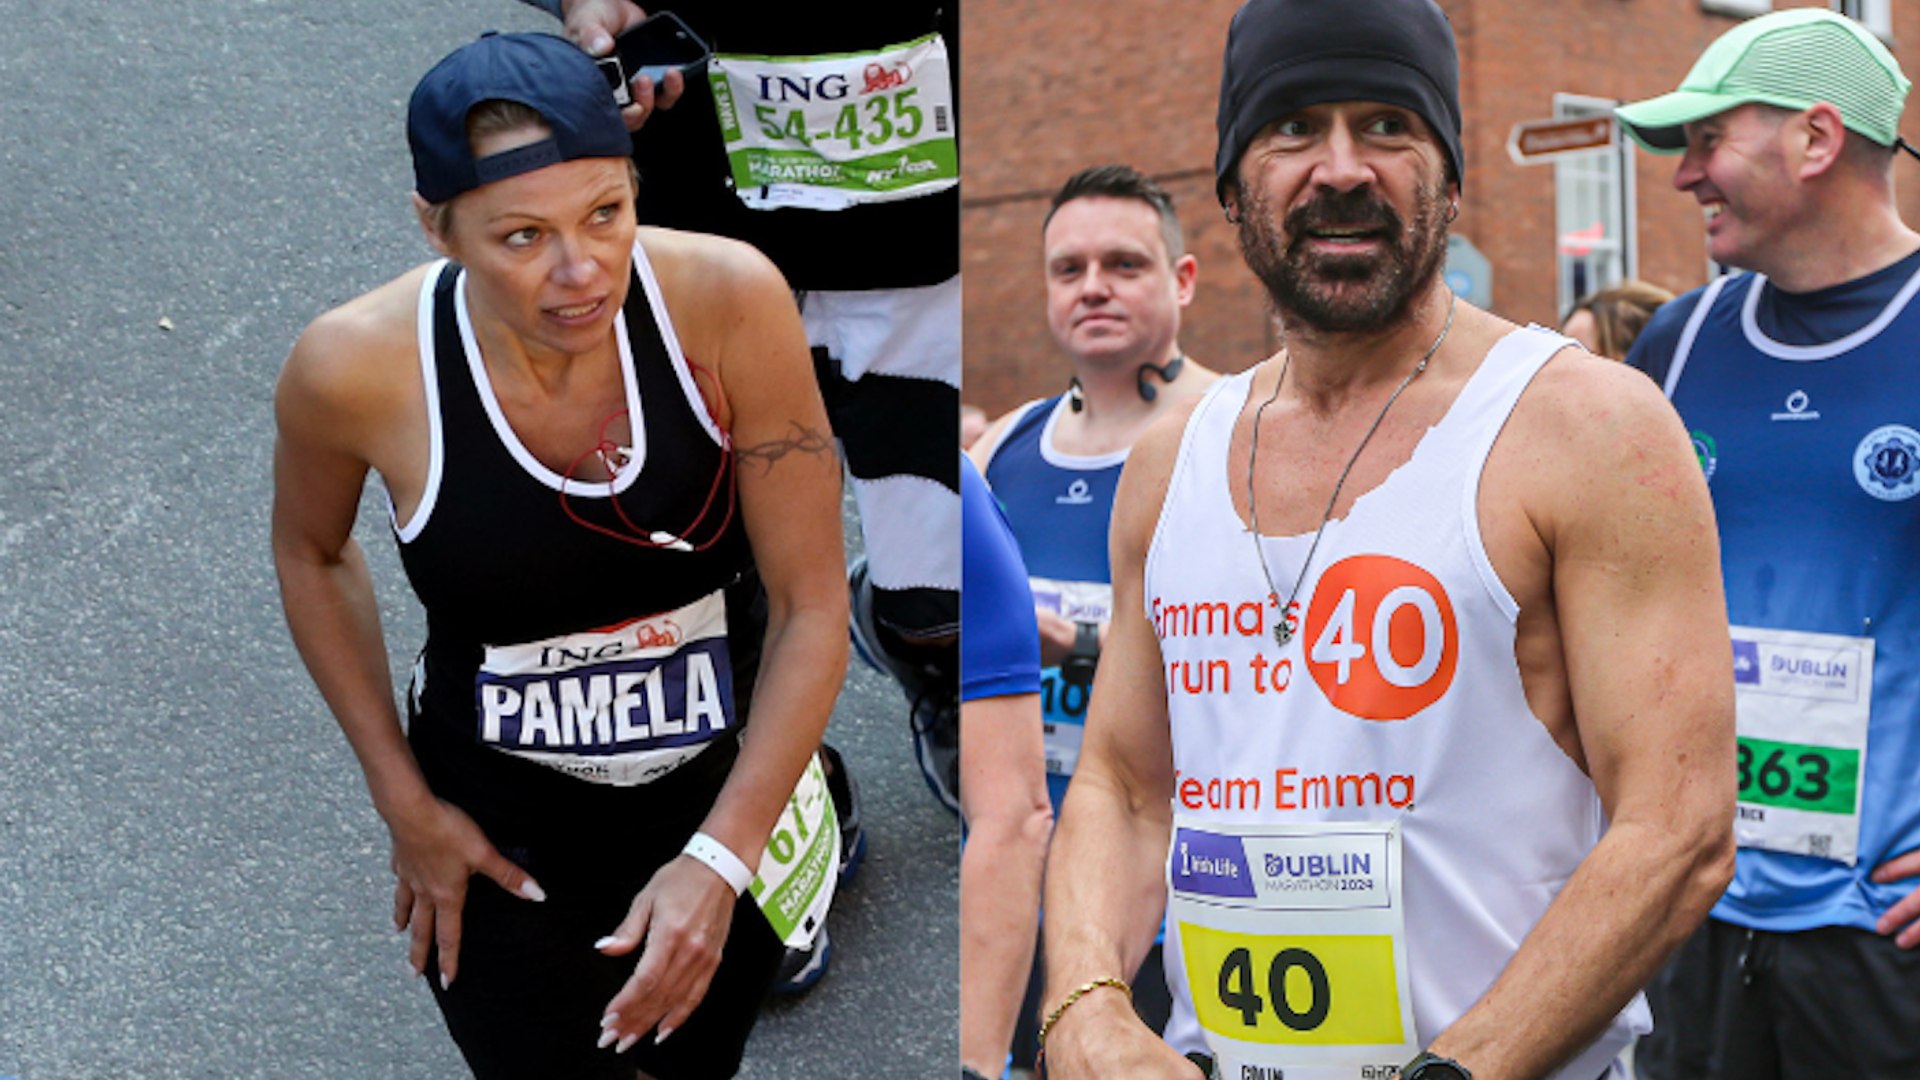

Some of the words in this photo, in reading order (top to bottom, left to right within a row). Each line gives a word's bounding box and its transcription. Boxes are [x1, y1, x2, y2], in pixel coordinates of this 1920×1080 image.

[756, 74, 850, 102] ING
[755, 88, 923, 150] 54-435
[1310, 585, 1445, 688] 40
[540, 641, 623, 668] ING
[1770, 654, 1848, 679] DUBLIN
[1170, 659, 1229, 694] run
[1250, 653, 1293, 694] to
[481, 651, 726, 746] PAMELA
[1175, 770, 1261, 811] eam
[1275, 767, 1416, 810] Emma
[1215, 857, 1238, 878] Life
[1264, 853, 1371, 878] DUBLIN
[1341, 879, 1374, 891] 2024
[1217, 947, 1332, 1032] 40
